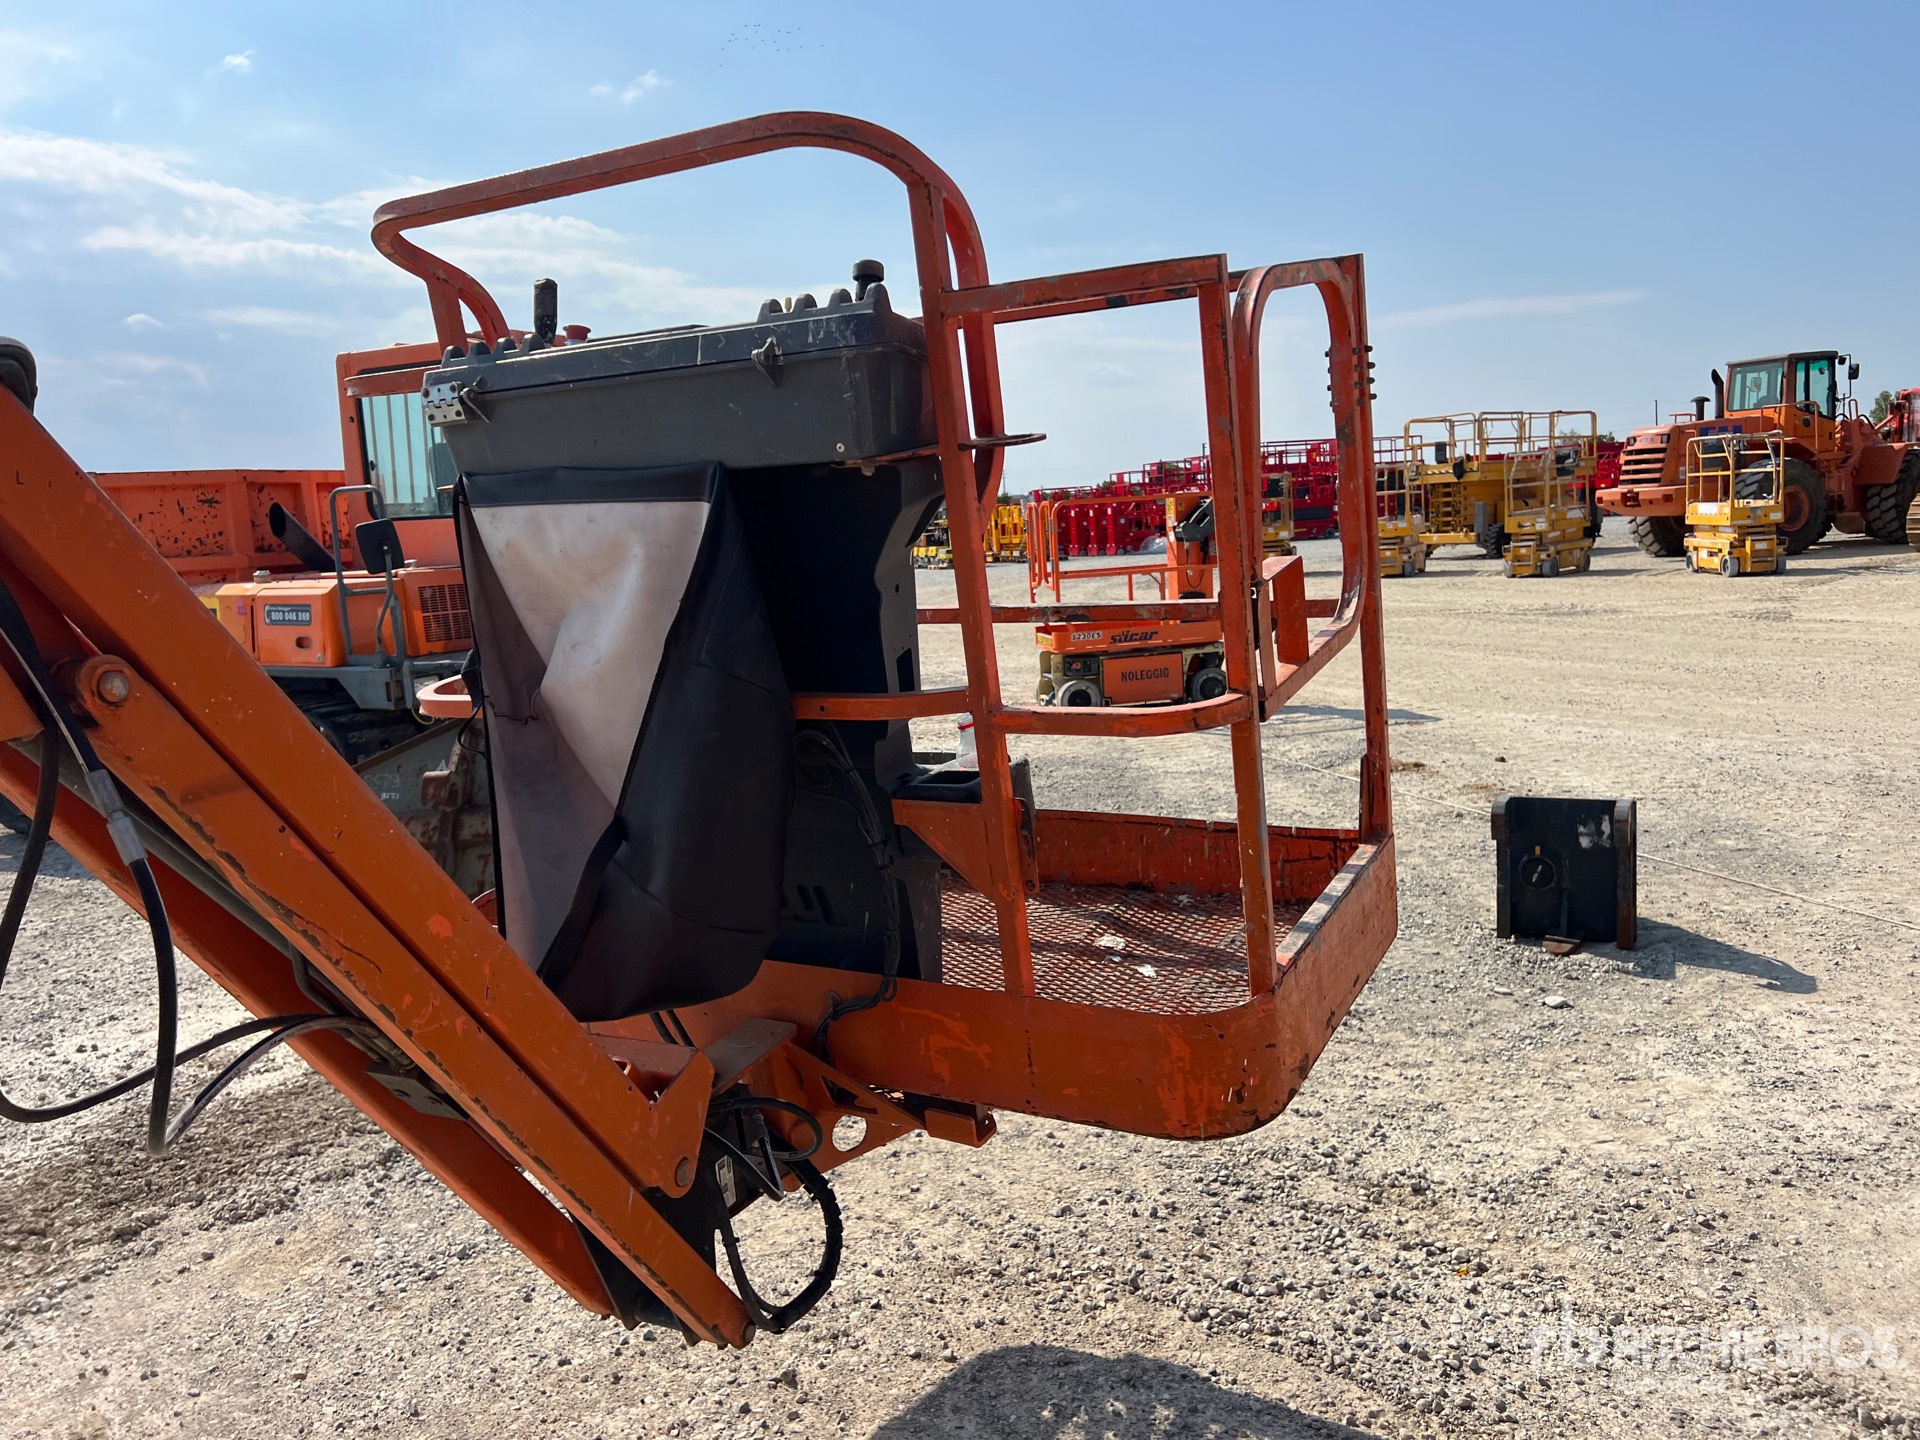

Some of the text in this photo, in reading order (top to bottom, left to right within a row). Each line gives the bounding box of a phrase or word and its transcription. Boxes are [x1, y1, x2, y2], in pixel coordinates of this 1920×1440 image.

[271, 611, 283, 621] 800
[284, 611, 297, 621] 046
[1121, 667, 1170, 683] NOLEGGIO
